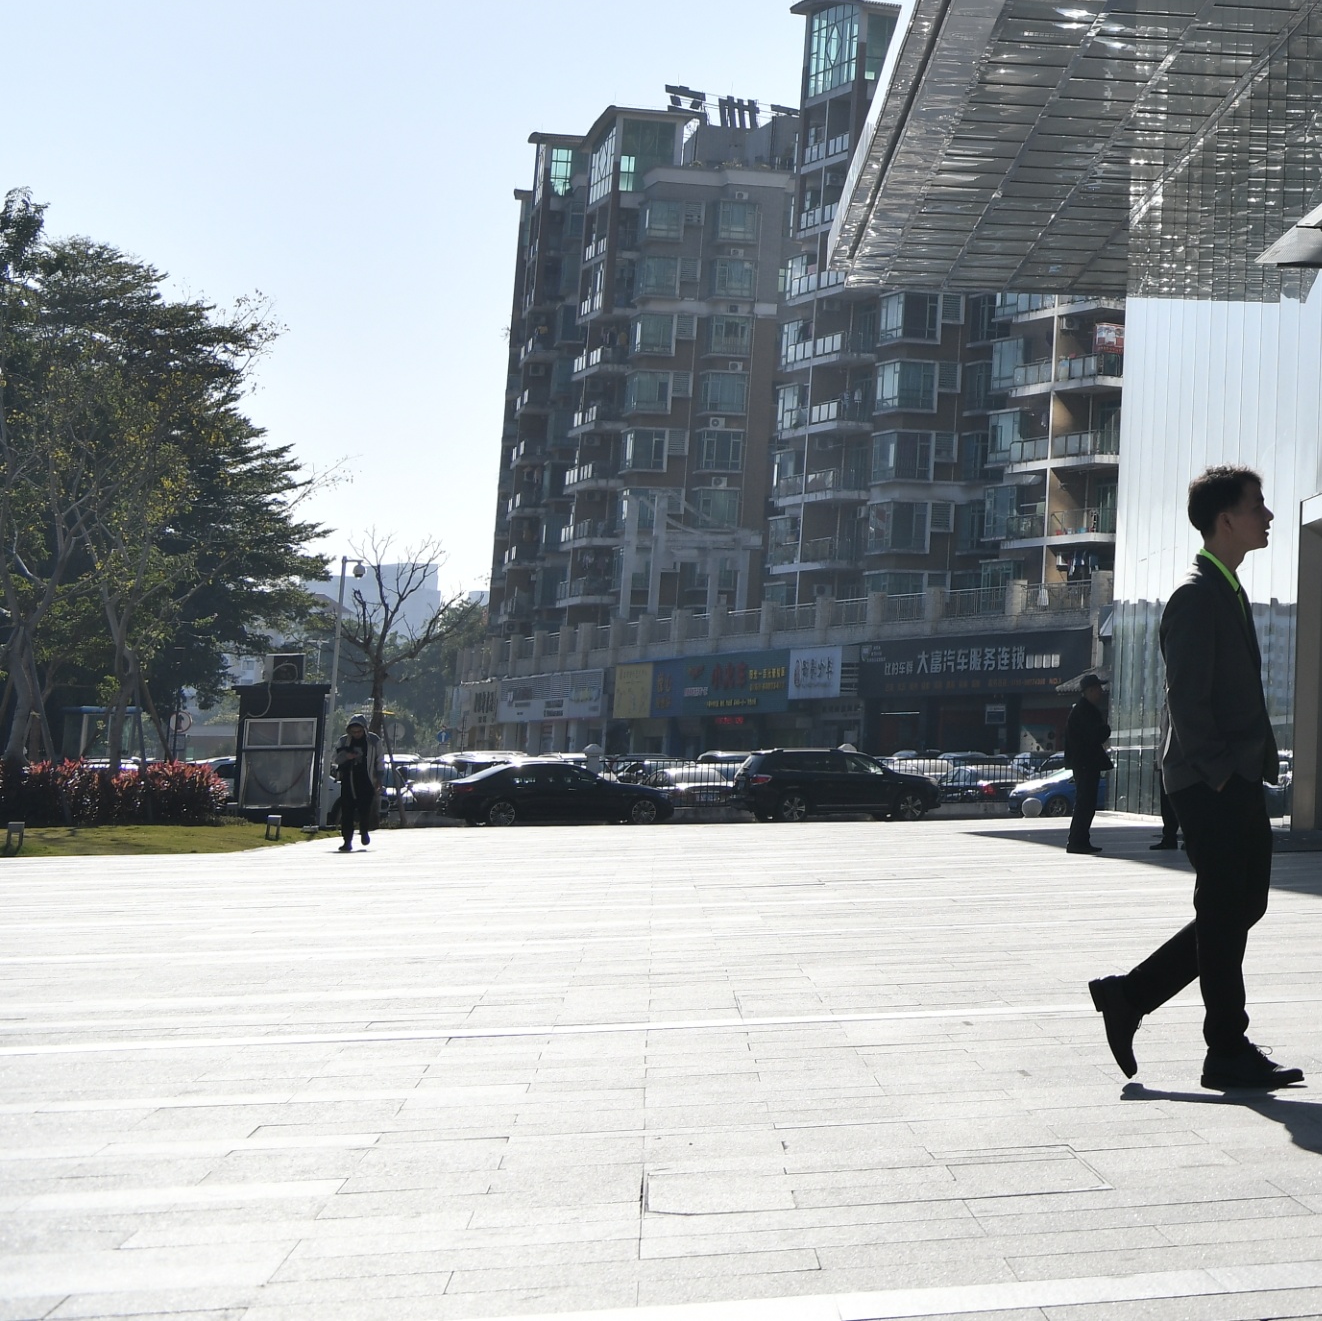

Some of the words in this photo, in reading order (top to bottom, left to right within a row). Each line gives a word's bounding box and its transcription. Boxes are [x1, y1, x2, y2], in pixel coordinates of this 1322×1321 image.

[916, 646, 1026, 674] 大富汽车服务连锁
